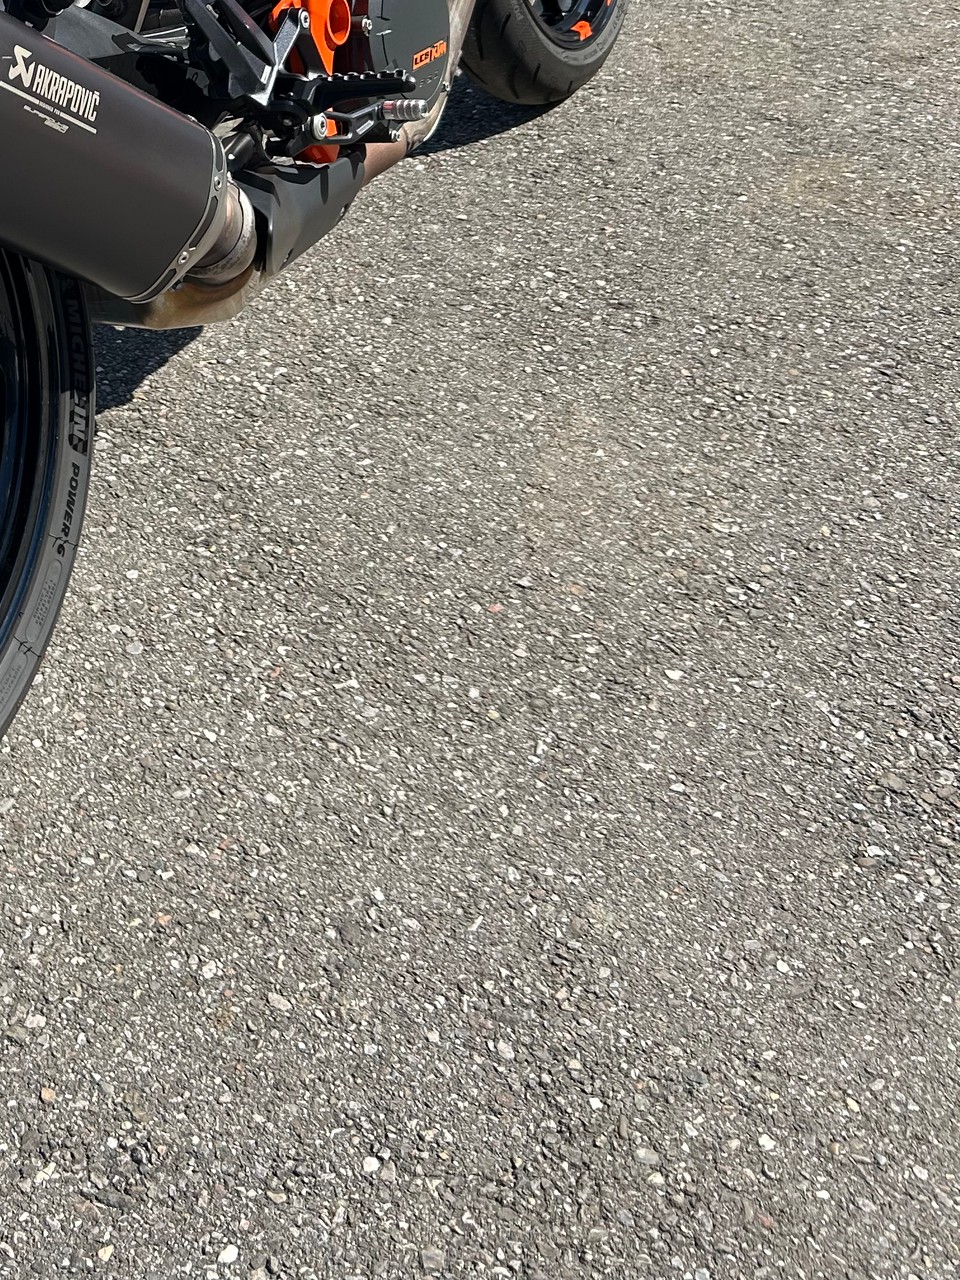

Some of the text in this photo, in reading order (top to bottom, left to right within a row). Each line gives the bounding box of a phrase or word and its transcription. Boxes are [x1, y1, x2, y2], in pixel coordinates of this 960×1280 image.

[32, 64, 100, 122] AKRAPOVIČ
[65, 299, 88, 440] MICHELIN
[57, 461, 80, 557] POWER 6
